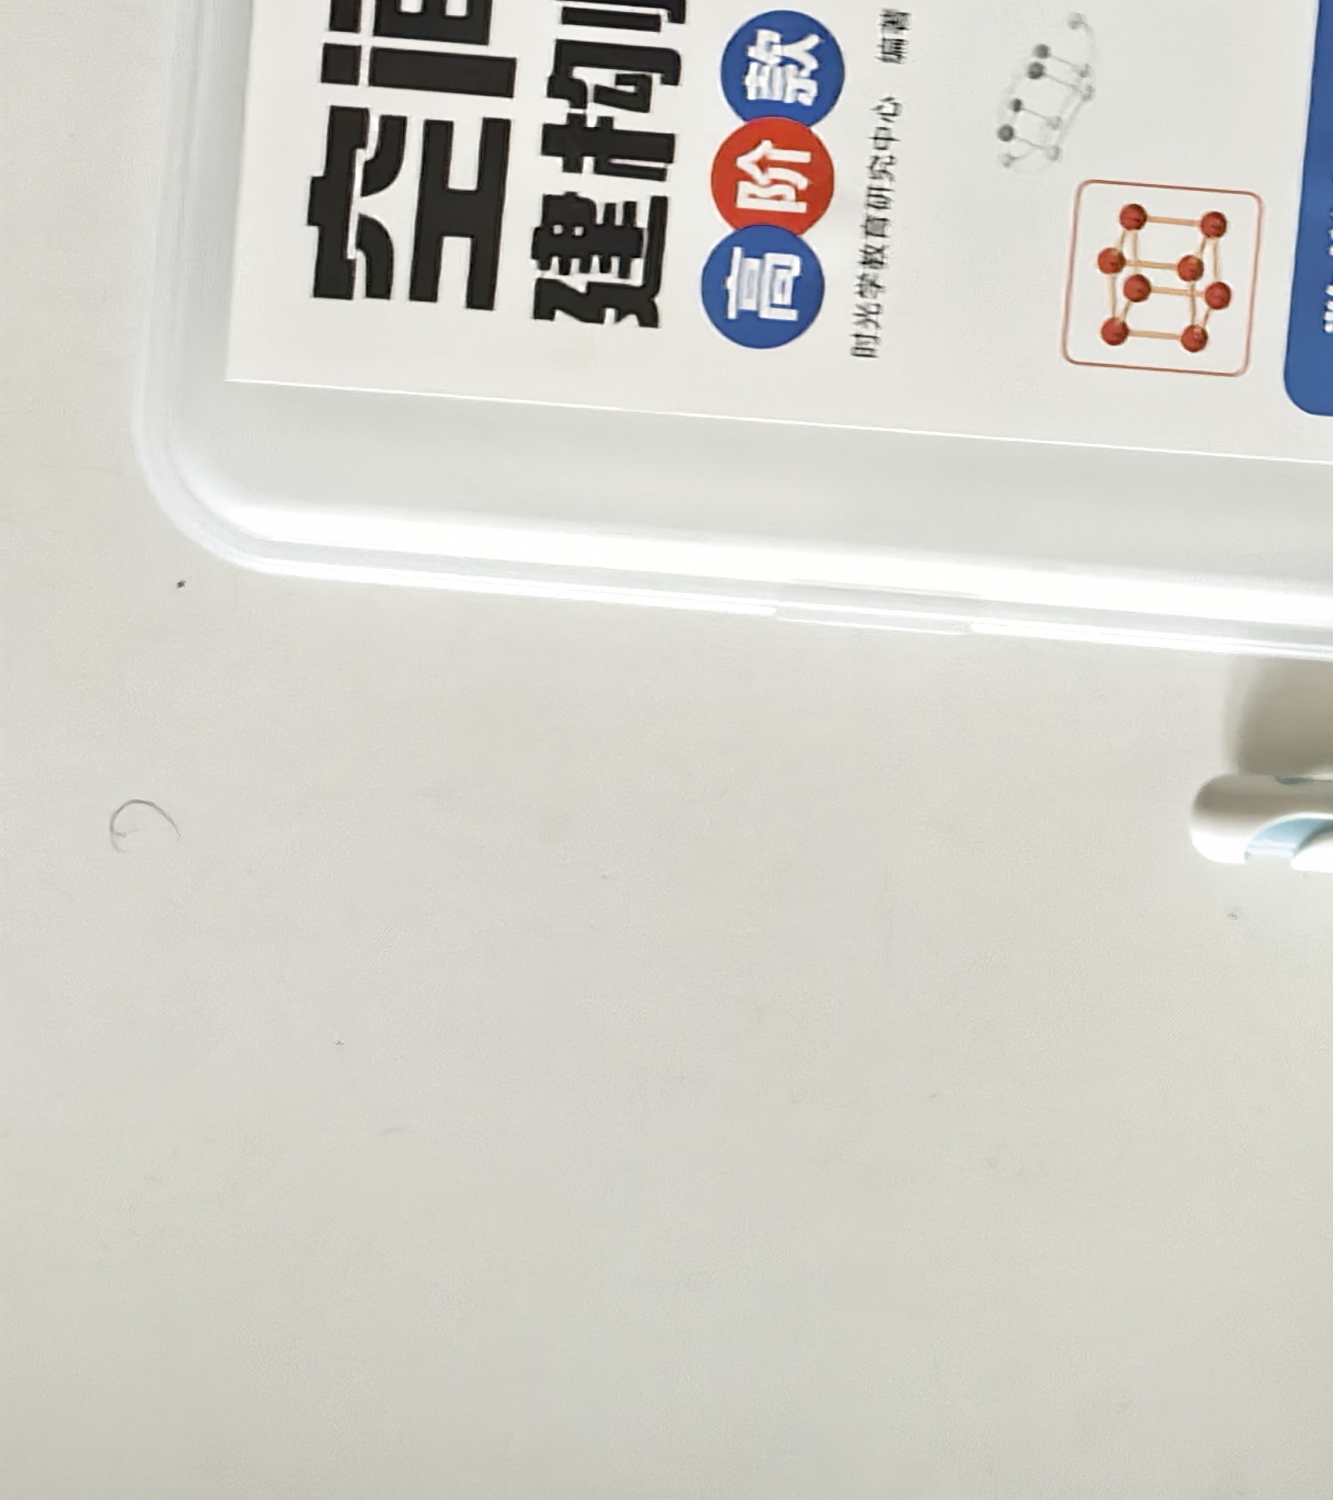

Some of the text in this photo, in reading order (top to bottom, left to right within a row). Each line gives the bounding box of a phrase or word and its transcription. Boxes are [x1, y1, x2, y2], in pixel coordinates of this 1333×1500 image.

[726, 28, 824, 320] 高阶款
[850, 8, 911, 360] 时光学教育研究中心 编著
